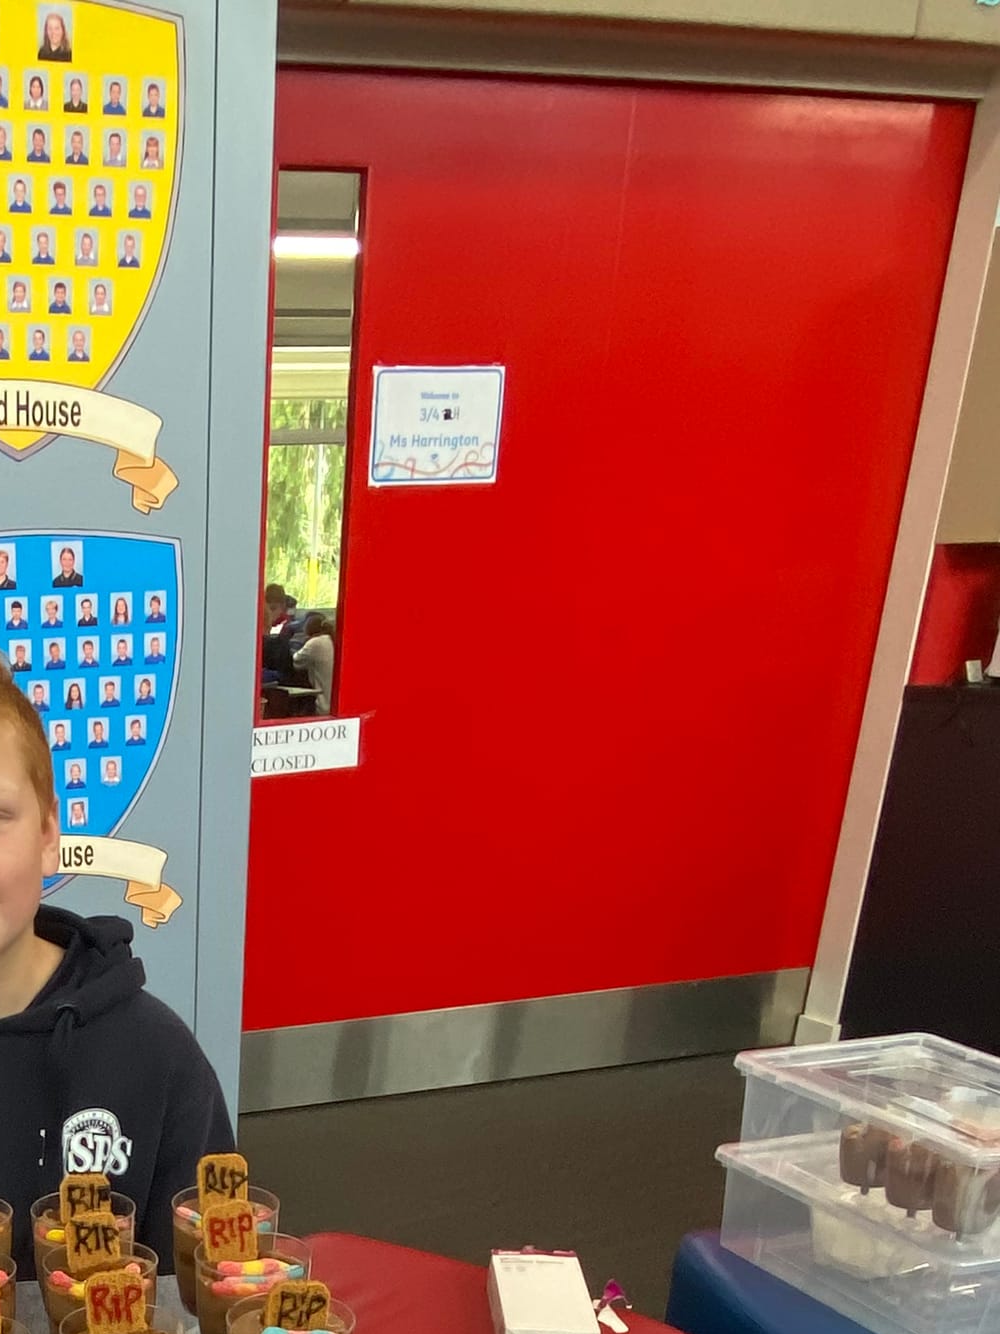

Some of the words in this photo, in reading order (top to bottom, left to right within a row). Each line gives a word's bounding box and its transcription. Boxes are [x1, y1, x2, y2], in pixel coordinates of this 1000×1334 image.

[16, 389, 82, 427] House
[389, 434, 408, 448] Ms
[411, 433, 480, 451] Harrington
[253, 729, 294, 747] KEEP
[298, 724, 347, 743] DOOR
[251, 754, 316, 774] CLOSED
[61, 845, 94, 868] use
[67, 1132, 133, 1176] SPS
